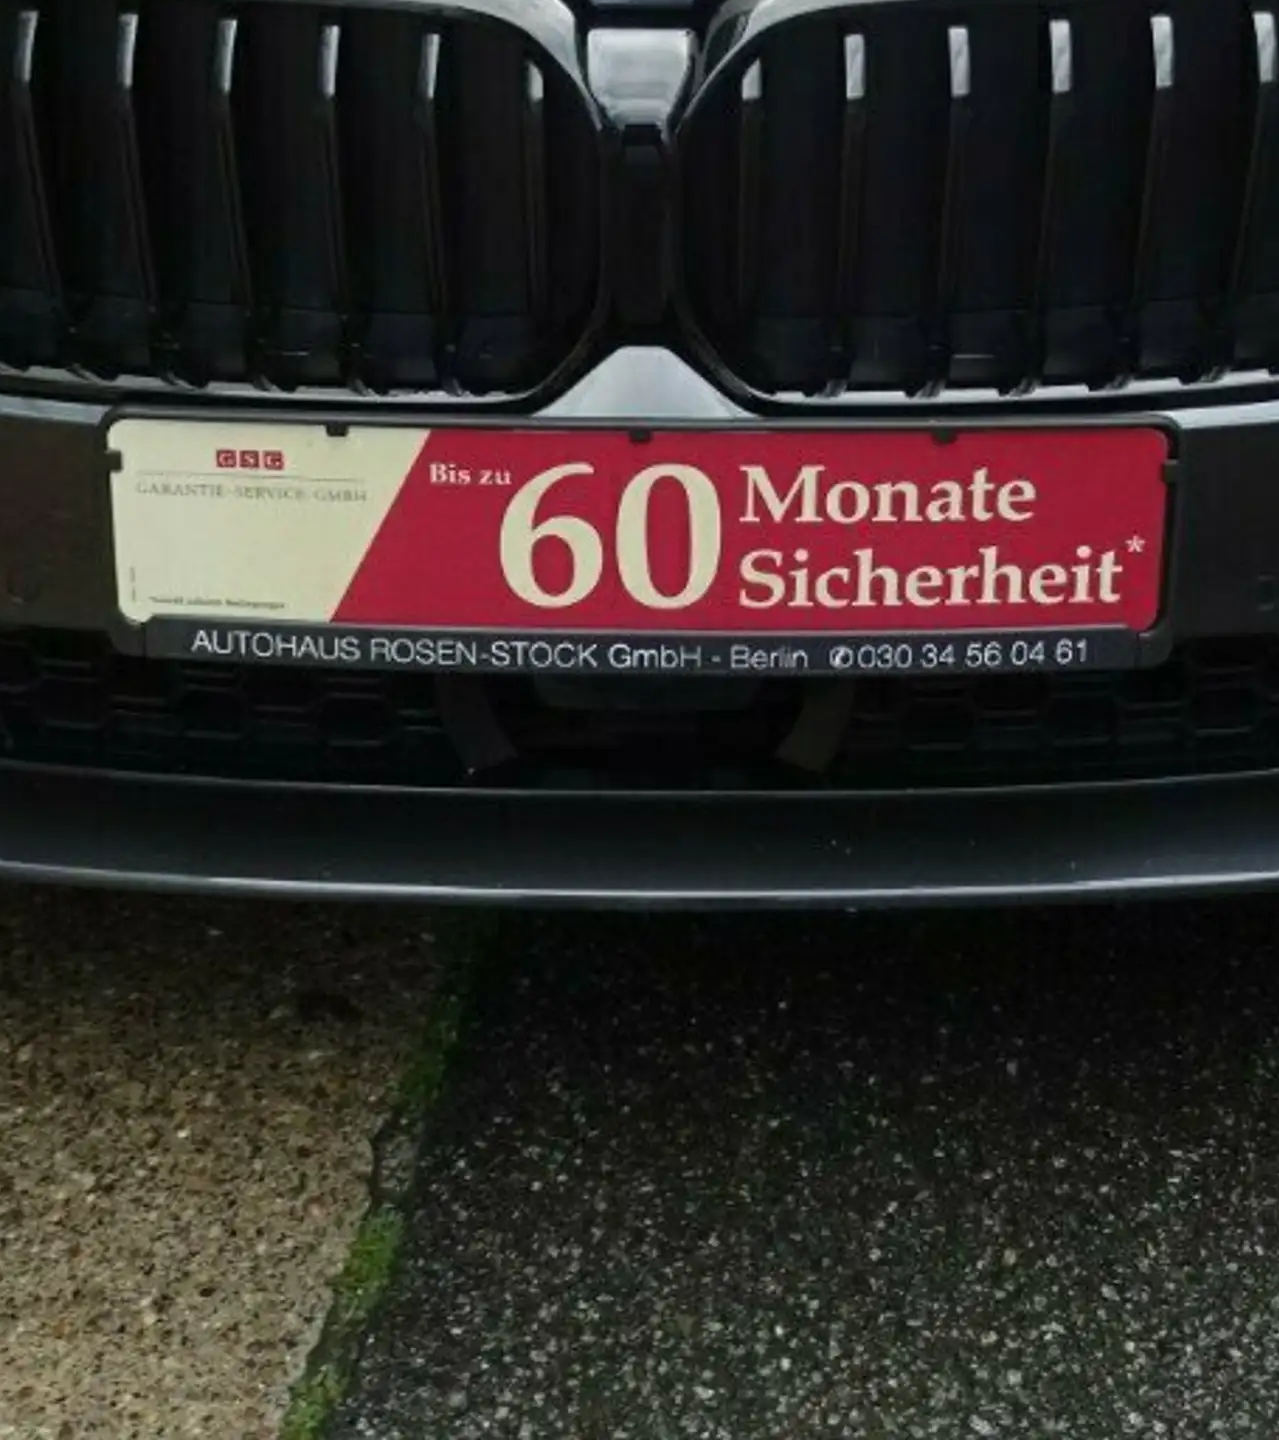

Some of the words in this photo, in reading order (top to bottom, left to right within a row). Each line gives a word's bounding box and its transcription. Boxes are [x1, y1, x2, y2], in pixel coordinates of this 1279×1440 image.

[430, 463, 471, 485] Bis
[477, 467, 513, 486] zu
[739, 464, 1037, 525] Monate
[499, 460, 722, 610] 60
[190, 629, 361, 662] AUTOHAUS
[370, 637, 599, 669] ROSEN-STOCK
[607, 643, 702, 669] GmbH
[730, 644, 809, 669] Berlin
[920, 642, 955, 667] 34
[964, 640, 1003, 666] 56
[1011, 640, 1047, 665] 04
[1056, 638, 1090, 663] 61
